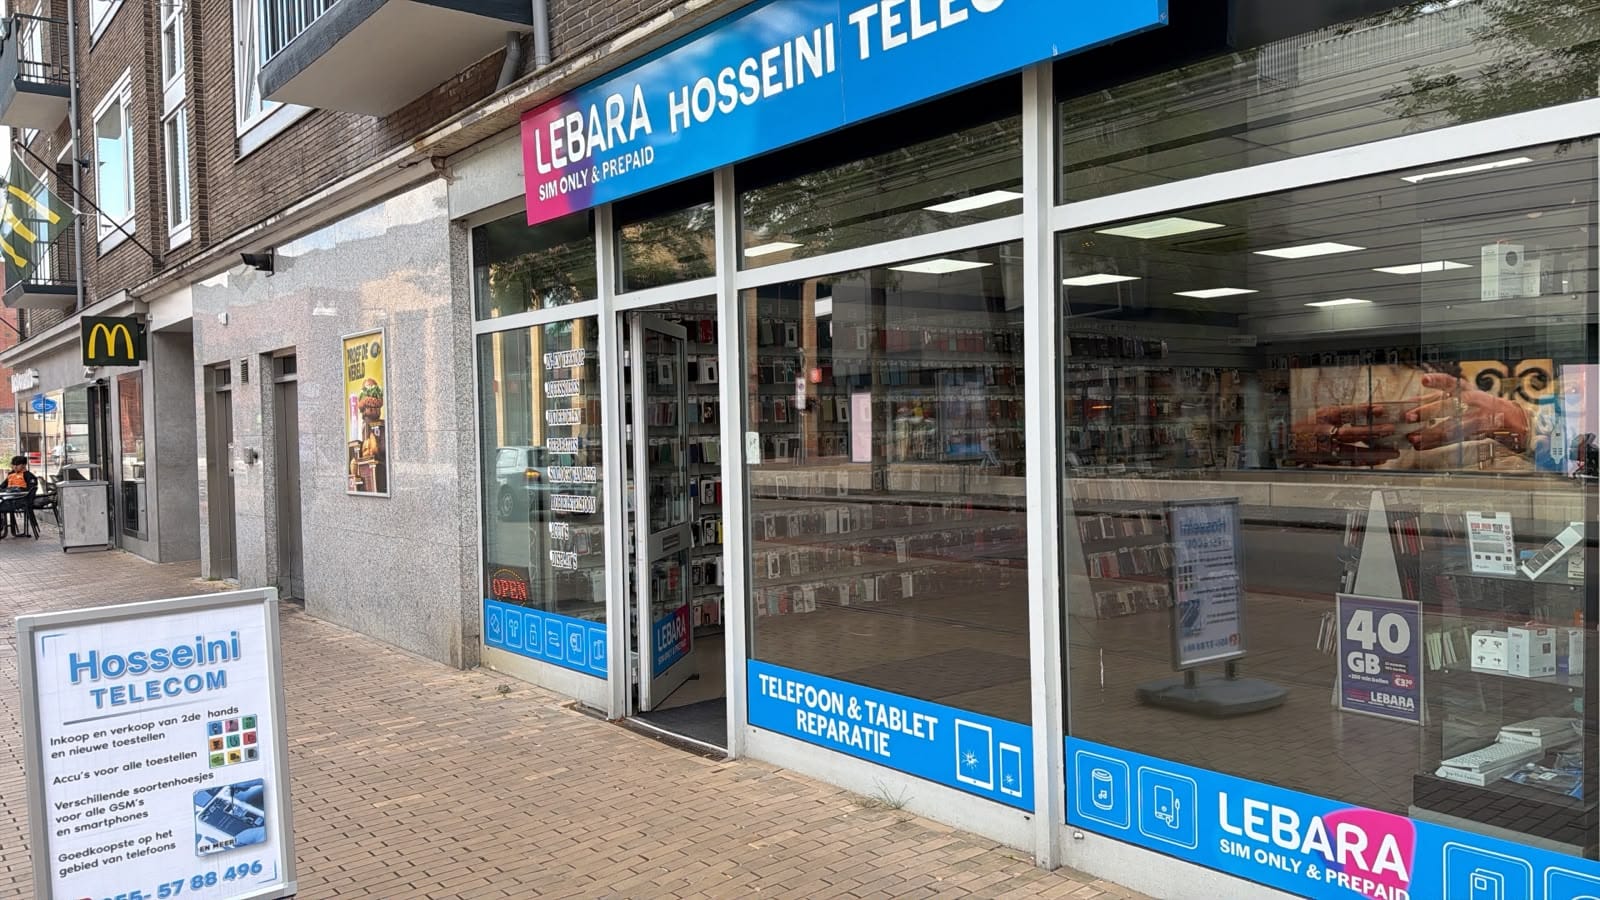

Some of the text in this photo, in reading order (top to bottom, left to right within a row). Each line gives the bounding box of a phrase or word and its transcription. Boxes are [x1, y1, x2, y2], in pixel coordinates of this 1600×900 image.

[669, 0, 1005, 133] HOSSEINI TELE
[534, 83, 652, 174] LEBARA
[539, 146, 654, 201] SIM ONLY & PREPAID
[493, 578, 528, 601] OPEN
[657, 613, 686, 652] LEBARA
[1346, 609, 1411, 654] 40
[69, 631, 240, 684] Hosseini
[1347, 651, 1381, 675] GB
[90, 670, 227, 709] TELECOM
[759, 673, 938, 741] TELEFOON & TABLET
[1370, 691, 1415, 709] LEBARA
[50, 706, 239, 746] Inkoop en verkoop van 2de hands
[51, 732, 165, 759] en nieuwe toestellen
[796, 708, 891, 757] REPARATIE
[53, 751, 197, 785] Accu's voor alle toestellen
[54, 772, 214, 810] Verschillende soortenhoesjes
[55, 798, 145, 823] voor alle GSM's
[56, 811, 149, 837] en smartphones
[1219, 791, 1410, 882] LEBARA
[58, 829, 173, 863] Goedkoopste op het
[59, 844, 177, 878] gebied van telefoons
[200, 845, 210, 853] EN
[157, 879, 185, 899] 57
[190, 871, 217, 892] 88
[222, 860, 263, 882] 496
[1219, 838, 1411, 900] SIM ONLY & PREPAID
